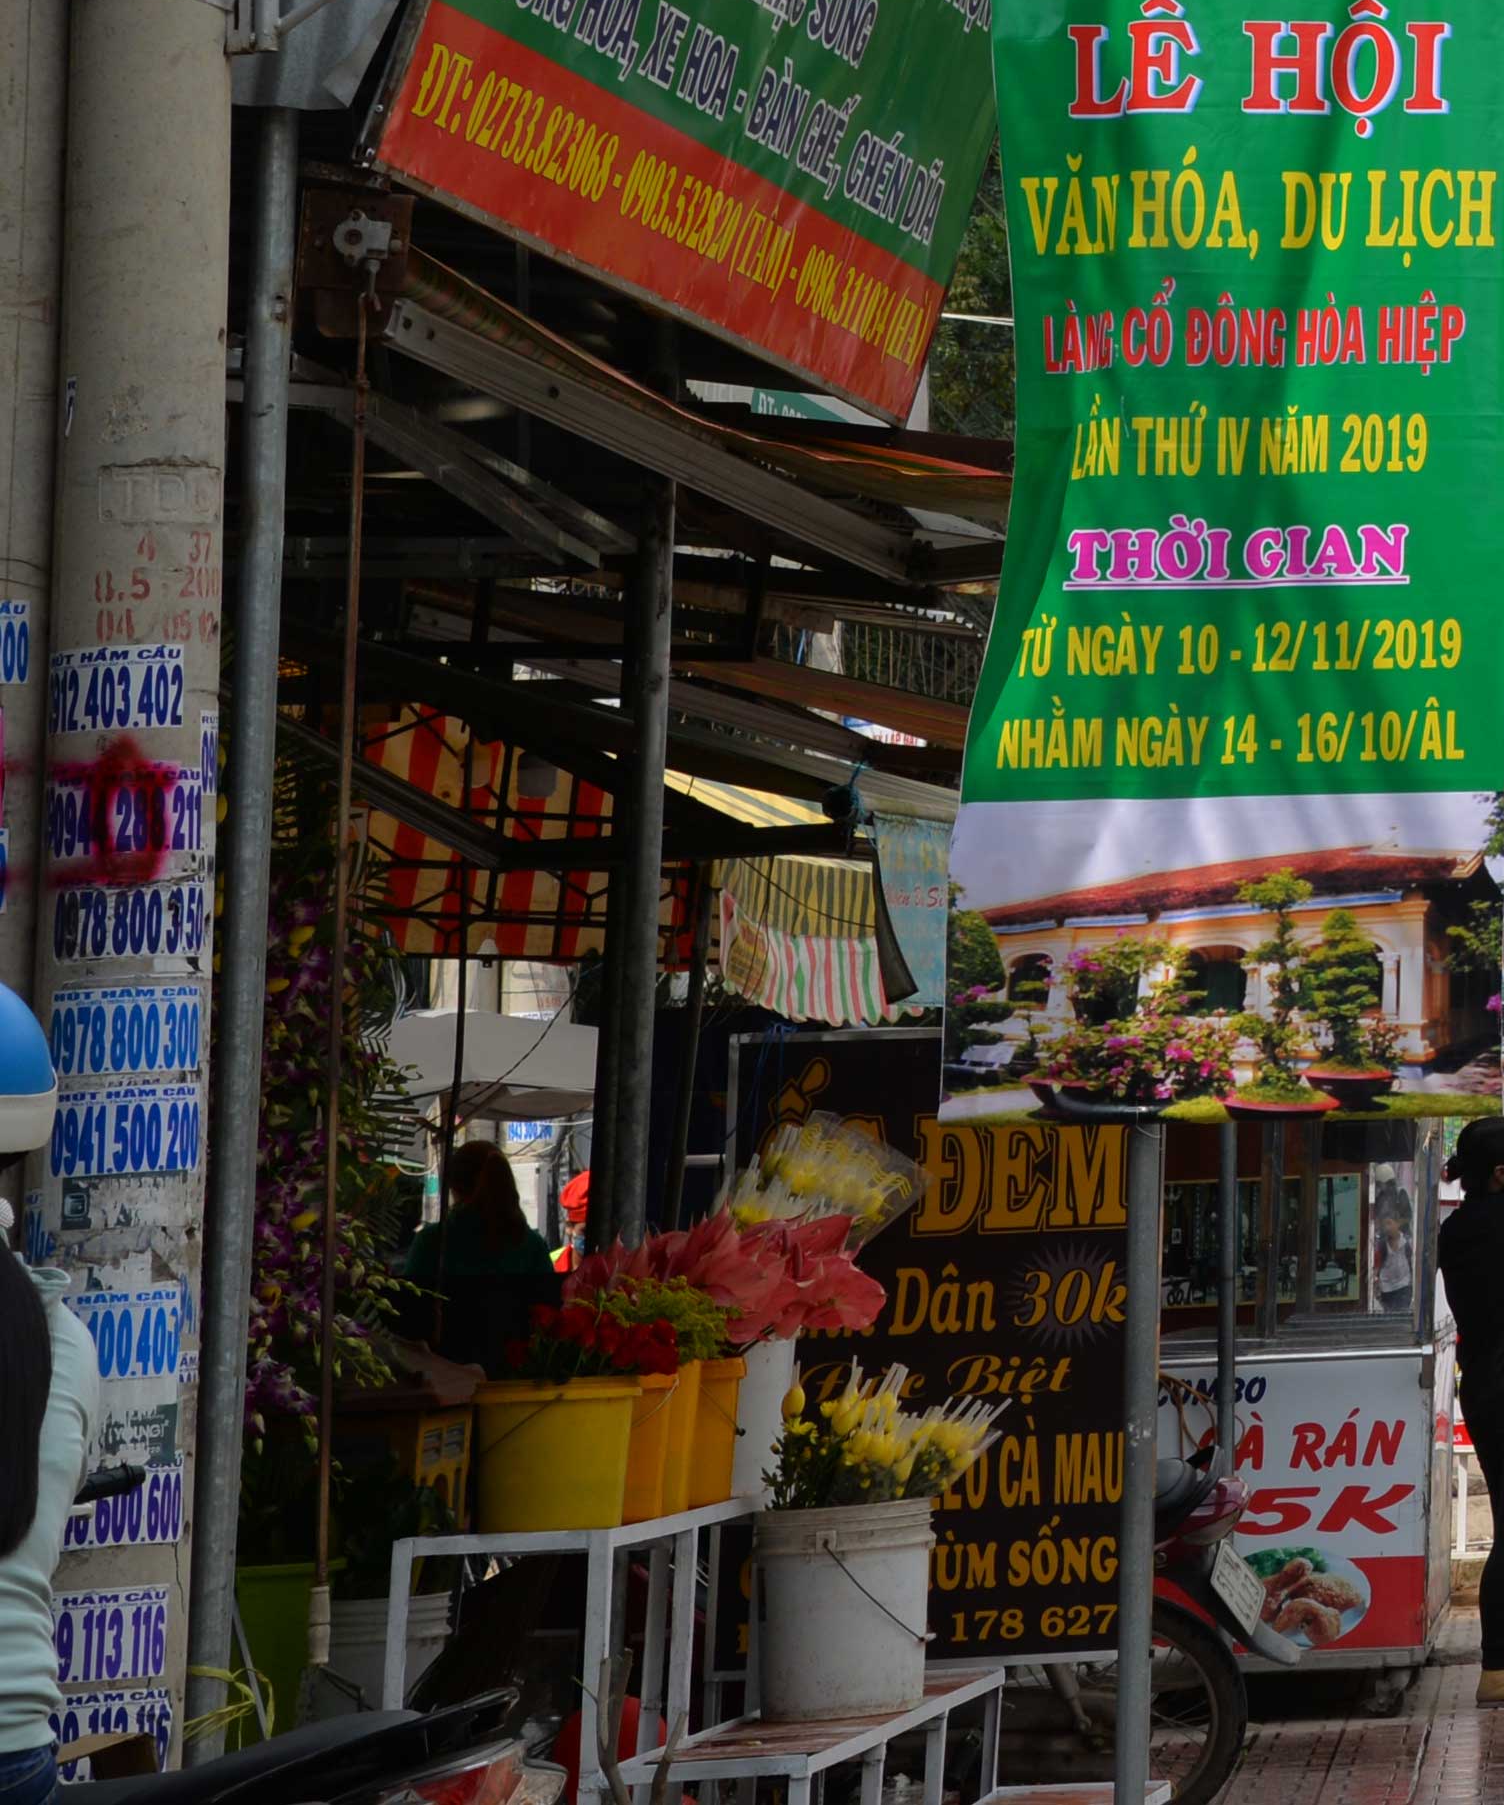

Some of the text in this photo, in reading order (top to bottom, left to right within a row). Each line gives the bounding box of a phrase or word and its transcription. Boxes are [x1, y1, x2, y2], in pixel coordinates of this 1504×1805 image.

[411, 43, 743, 265] ĐT: 02733.823068 0903.532820
[637, 0, 693, 86] XE
[676, 32, 744, 121] HOA
[744, 56, 800, 166] BÀN
[797, 92, 859, 199] GHẾ,
[843, 131, 911, 222] CHÉN
[906, 161, 946, 247] DĨA
[1020, 146, 1497, 268] VĂN HÓA, DU LỊCH
[1042, 276, 1465, 375] LÀNG CỔ ĐÔNG HÒA HIỆP
[1071, 394, 1428, 481] LẦN THỨ IV NĂM 2019
[1066, 515, 1410, 583] THỜI GIAN
[1016, 611, 1462, 679] TỪ NGÀY 10 12/11/2019
[996, 697, 1464, 770] NHẰM NGÀY 14 16/10/ÂL
[51, 1003, 199, 1074] 0978.800.300
[51, 1102, 199, 1177] 0941.500.200
[888, 1261, 1127, 1336] Dân 30k
[947, 1354, 1073, 1406] Biệt
[998, 1415, 1041, 1509] CÀ
[1054, 1432, 1123, 1505] MAU
[1289, 1407, 1406, 1472] RÁN
[1007, 1515, 1118, 1587] SỐNG
[951, 1603, 1118, 1643] 178 627
